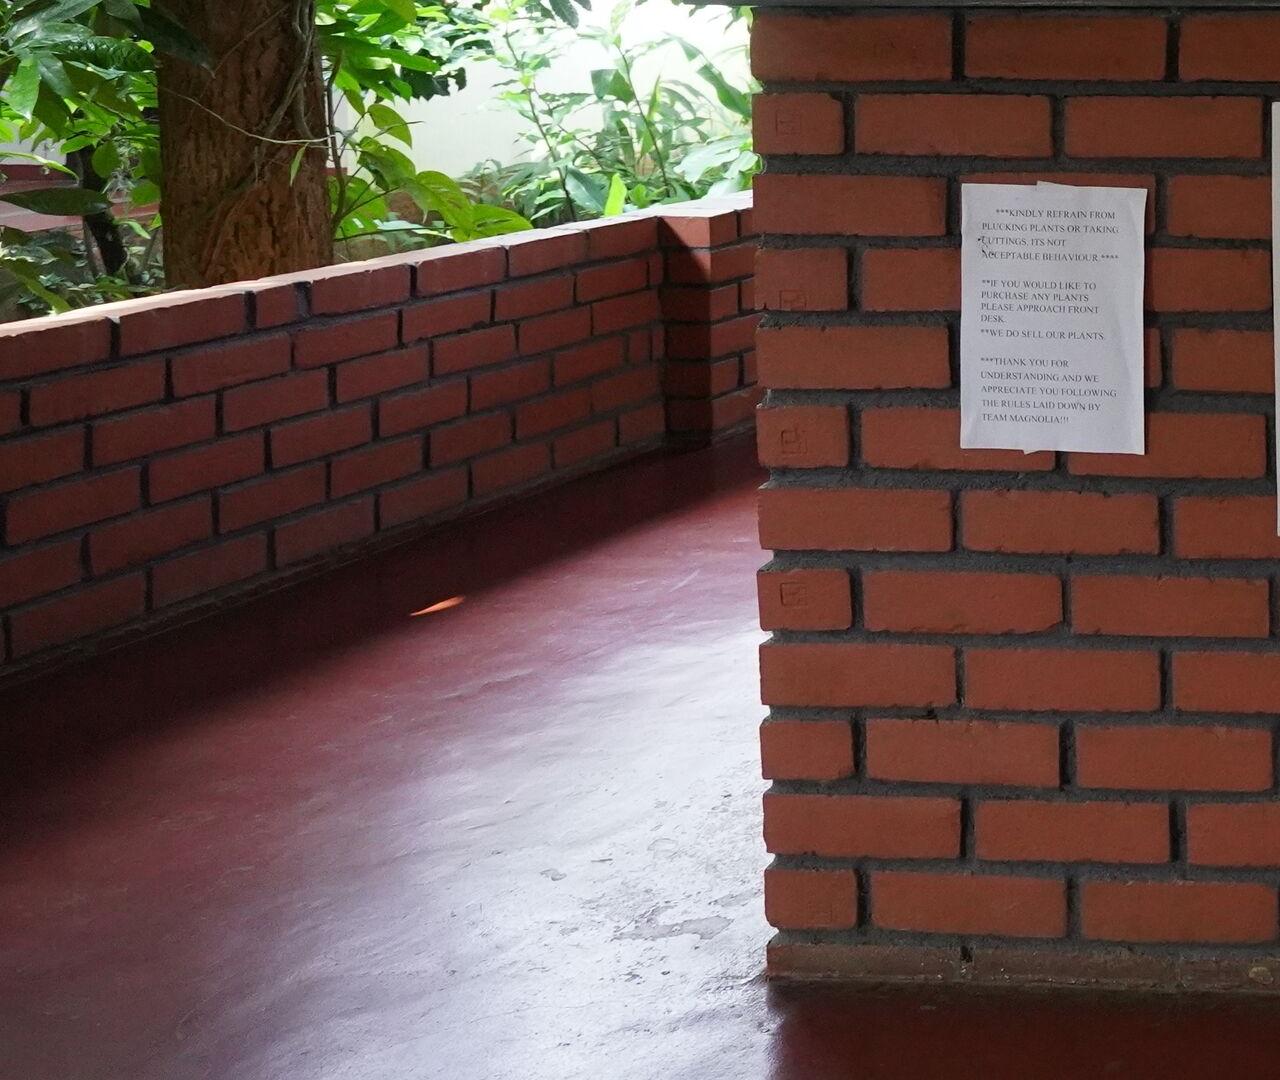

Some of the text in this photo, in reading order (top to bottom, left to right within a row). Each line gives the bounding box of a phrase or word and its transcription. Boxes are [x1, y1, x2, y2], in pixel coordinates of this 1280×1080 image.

[1046, 210, 1087, 218] REFRAIN
[1090, 211, 1115, 219] FROM
[982, 223, 1028, 231] PLUCKING
[1030, 224, 1064, 232] PLANTS
[1084, 225, 1119, 233] TAKING
[982, 251, 1040, 260] ACCEPTABLE
[1001, 280, 1020, 288] YOU
[1024, 281, 1056, 289] WOULD
[1083, 282, 1096, 290] TO
[981, 292, 1028, 300] PURCHASE
[981, 303, 1014, 311] PLEASE
[1016, 304, 1066, 313] APPROACH
[1006, 330, 1019, 338] DO
[1022, 330, 1043, 338] SELL
[1046, 331, 1065, 339] OUR
[1029, 359, 1048, 367] YOU
[981, 372, 1059, 381] UNDERSTANDING
[1062, 374, 1082, 382] AND
[982, 386, 1036, 394] APPRECIATE
[1061, 388, 1116, 397] FOLLOWING
[1001, 400, 1030, 408] RULES
[1058, 402, 1085, 410] DOWN
[1009, 415, 1069, 424] MAGNOLIA!!!
